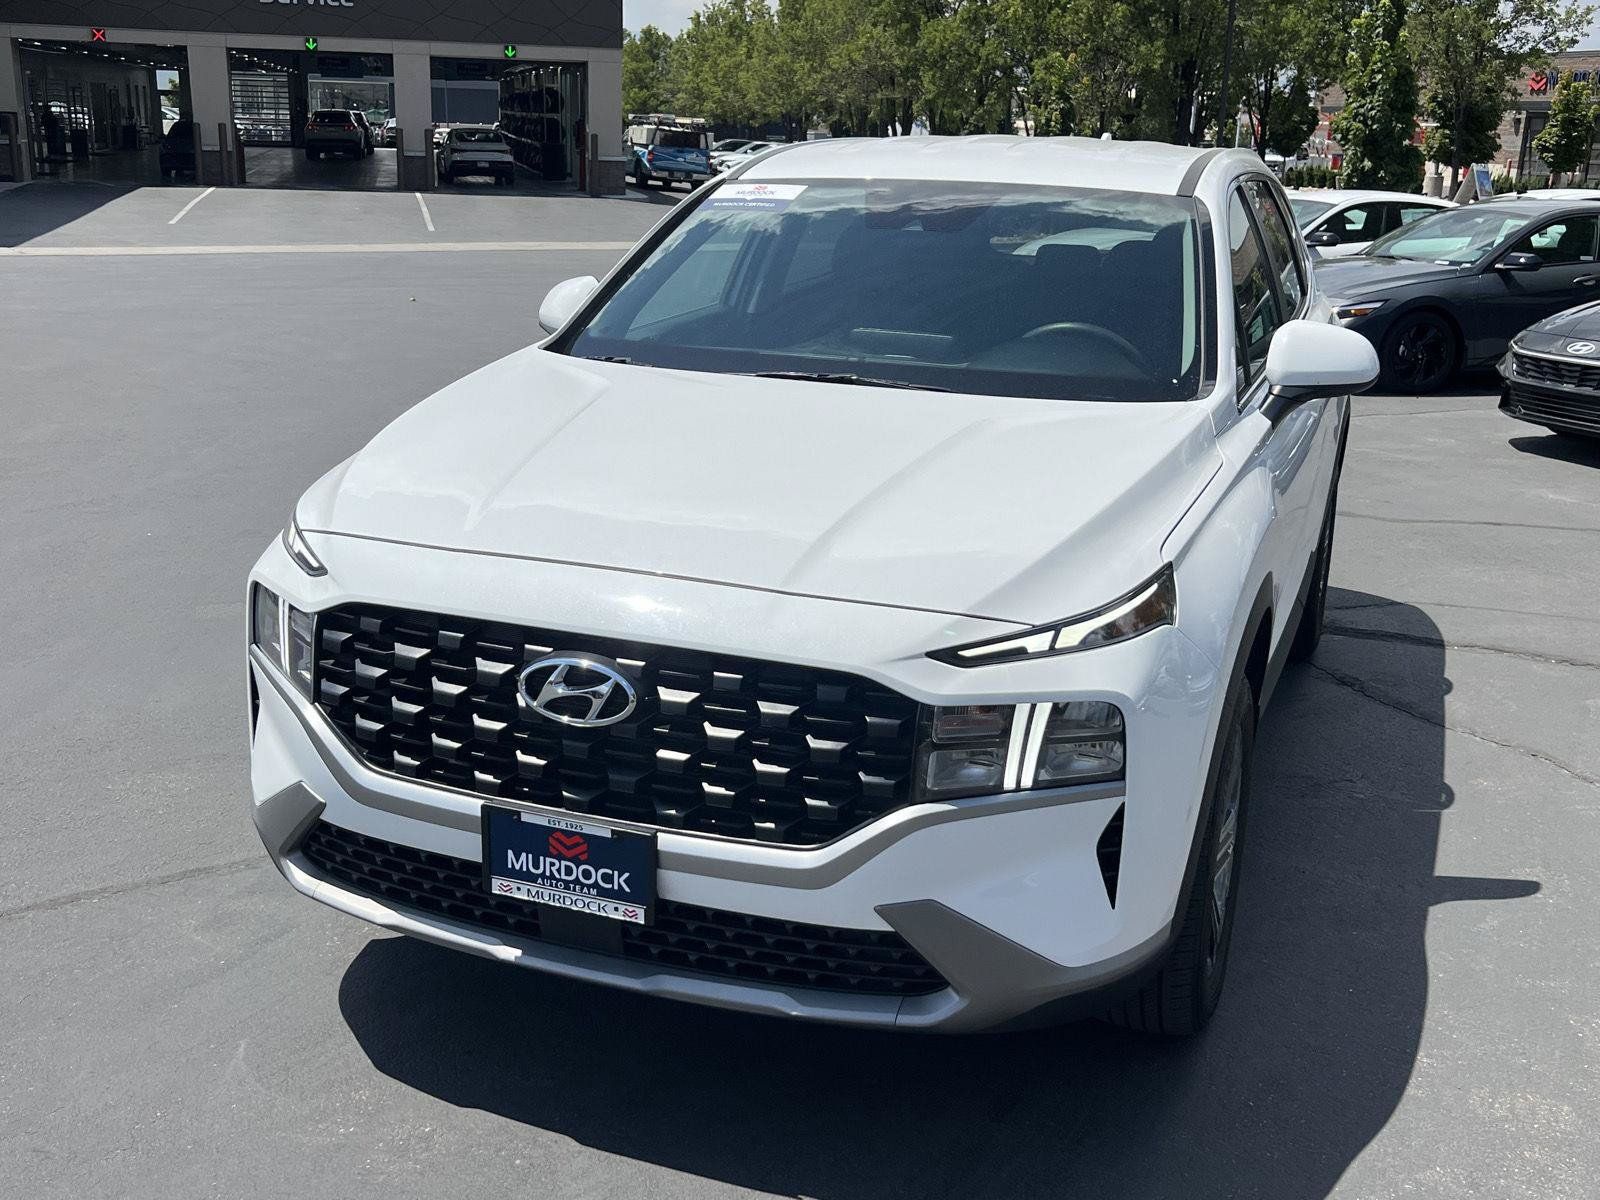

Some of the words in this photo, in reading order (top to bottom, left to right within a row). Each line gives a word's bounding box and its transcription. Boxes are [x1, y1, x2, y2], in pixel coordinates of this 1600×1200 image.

[547, 818, 564, 828] EST.
[565, 822, 584, 831] 1925
[507, 849, 631, 893] MURDOCK
[536, 877, 565, 889] AUTO
[569, 884, 597, 896] TEAM
[526, 888, 608, 914] MURDOCK
